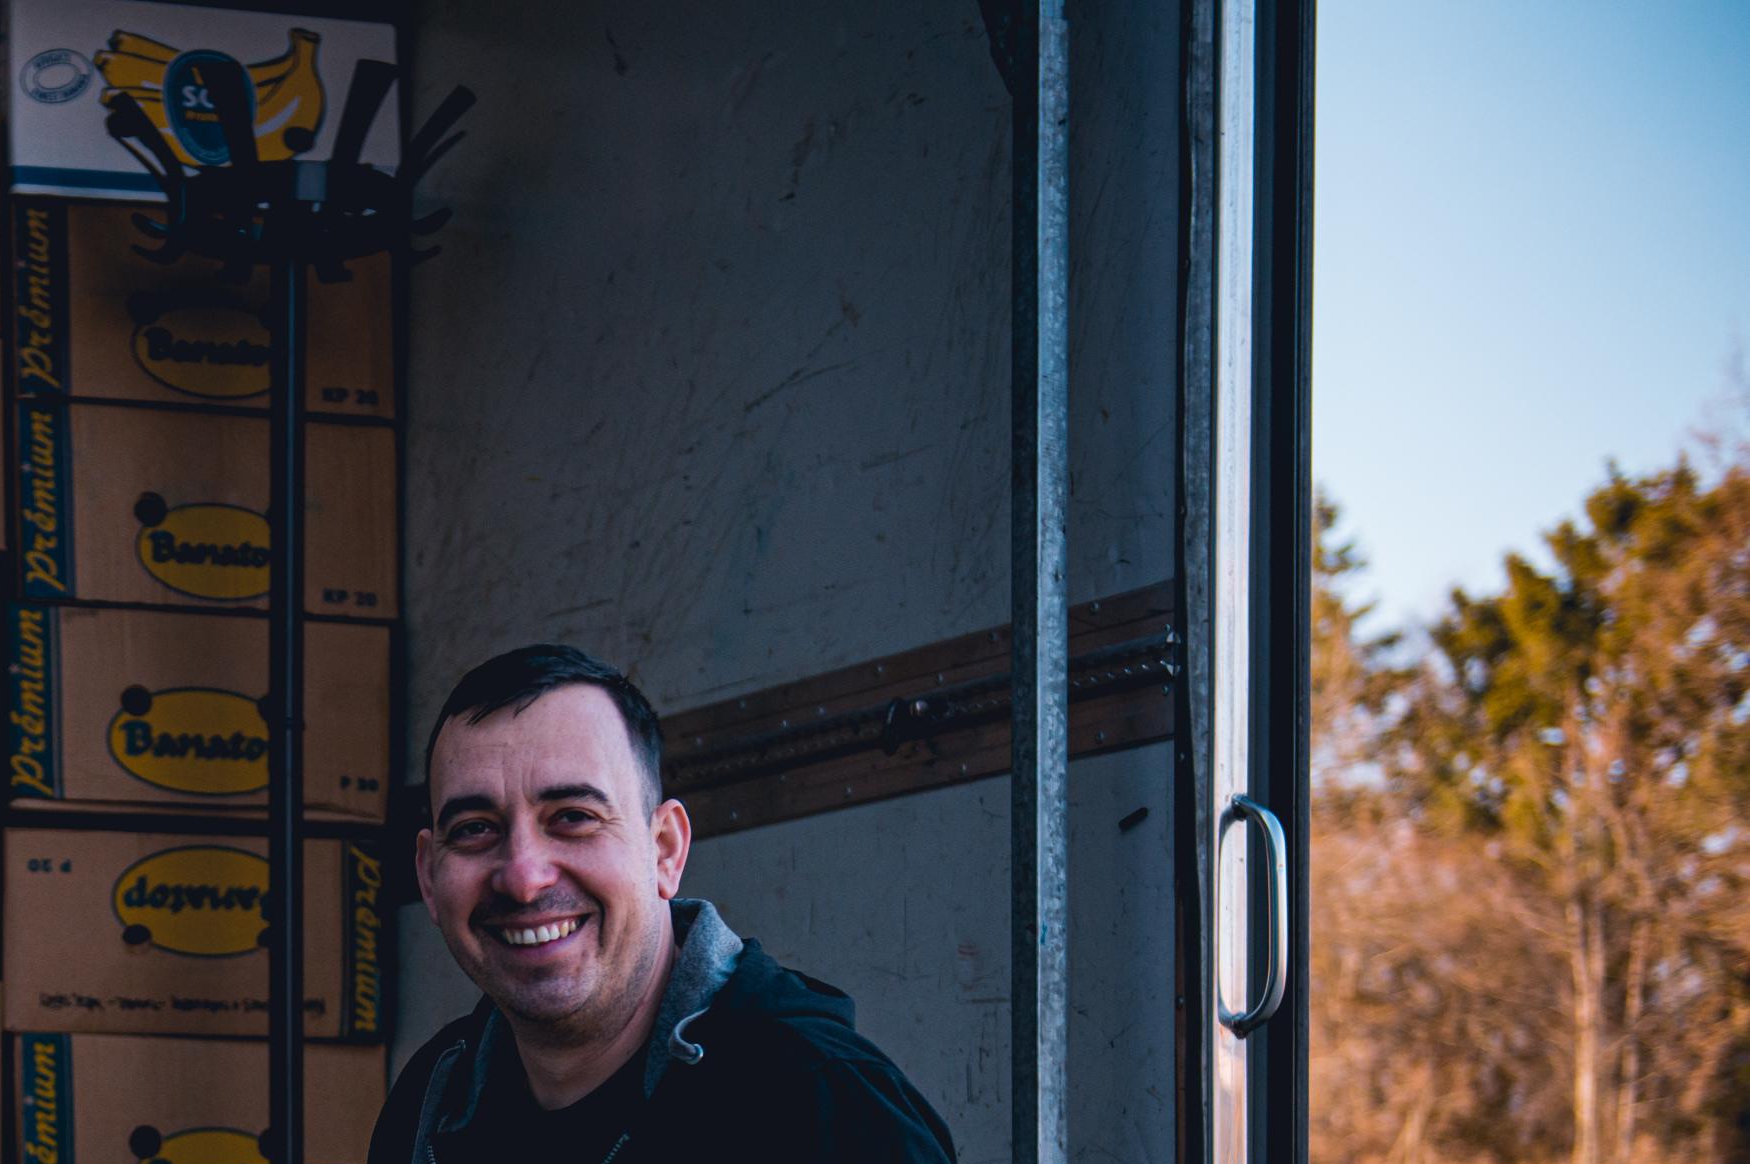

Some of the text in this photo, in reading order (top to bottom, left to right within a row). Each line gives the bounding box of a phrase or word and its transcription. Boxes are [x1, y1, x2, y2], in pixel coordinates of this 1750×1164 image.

[148, 530, 270, 568] Banato
[10, 608, 53, 795] Prémium
[120, 719, 270, 762] Banato
